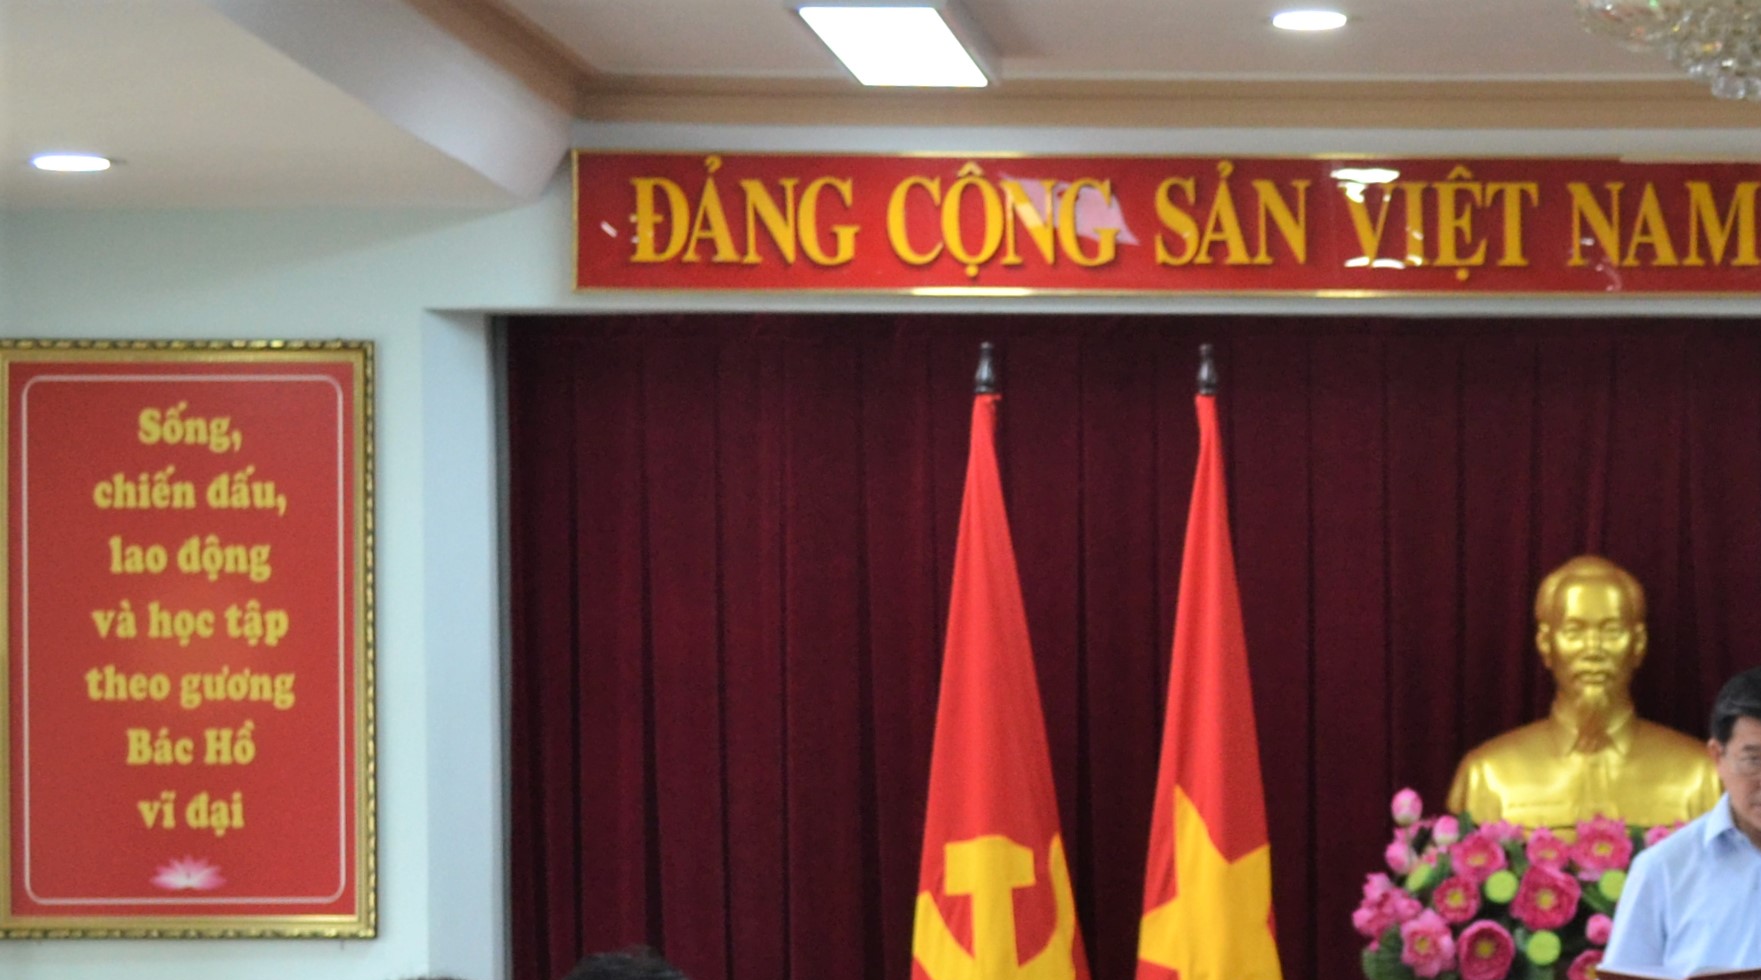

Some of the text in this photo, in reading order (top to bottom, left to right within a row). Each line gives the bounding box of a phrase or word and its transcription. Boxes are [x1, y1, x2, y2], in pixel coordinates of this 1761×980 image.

[630, 155, 860, 265] ĐẢNG
[886, 162, 1119, 279] CỘNG
[1154, 160, 1310, 266] SẢN
[1343, 165, 1539, 281] VIỆT
[1566, 182, 1761, 267] NAM
[138, 402, 243, 453] Sống,
[93, 465, 197, 509] chiến
[109, 534, 169, 574] lao
[92, 598, 290, 648] và học tập
[85, 663, 296, 710] theo gương
[127, 726, 195, 766] Bác
